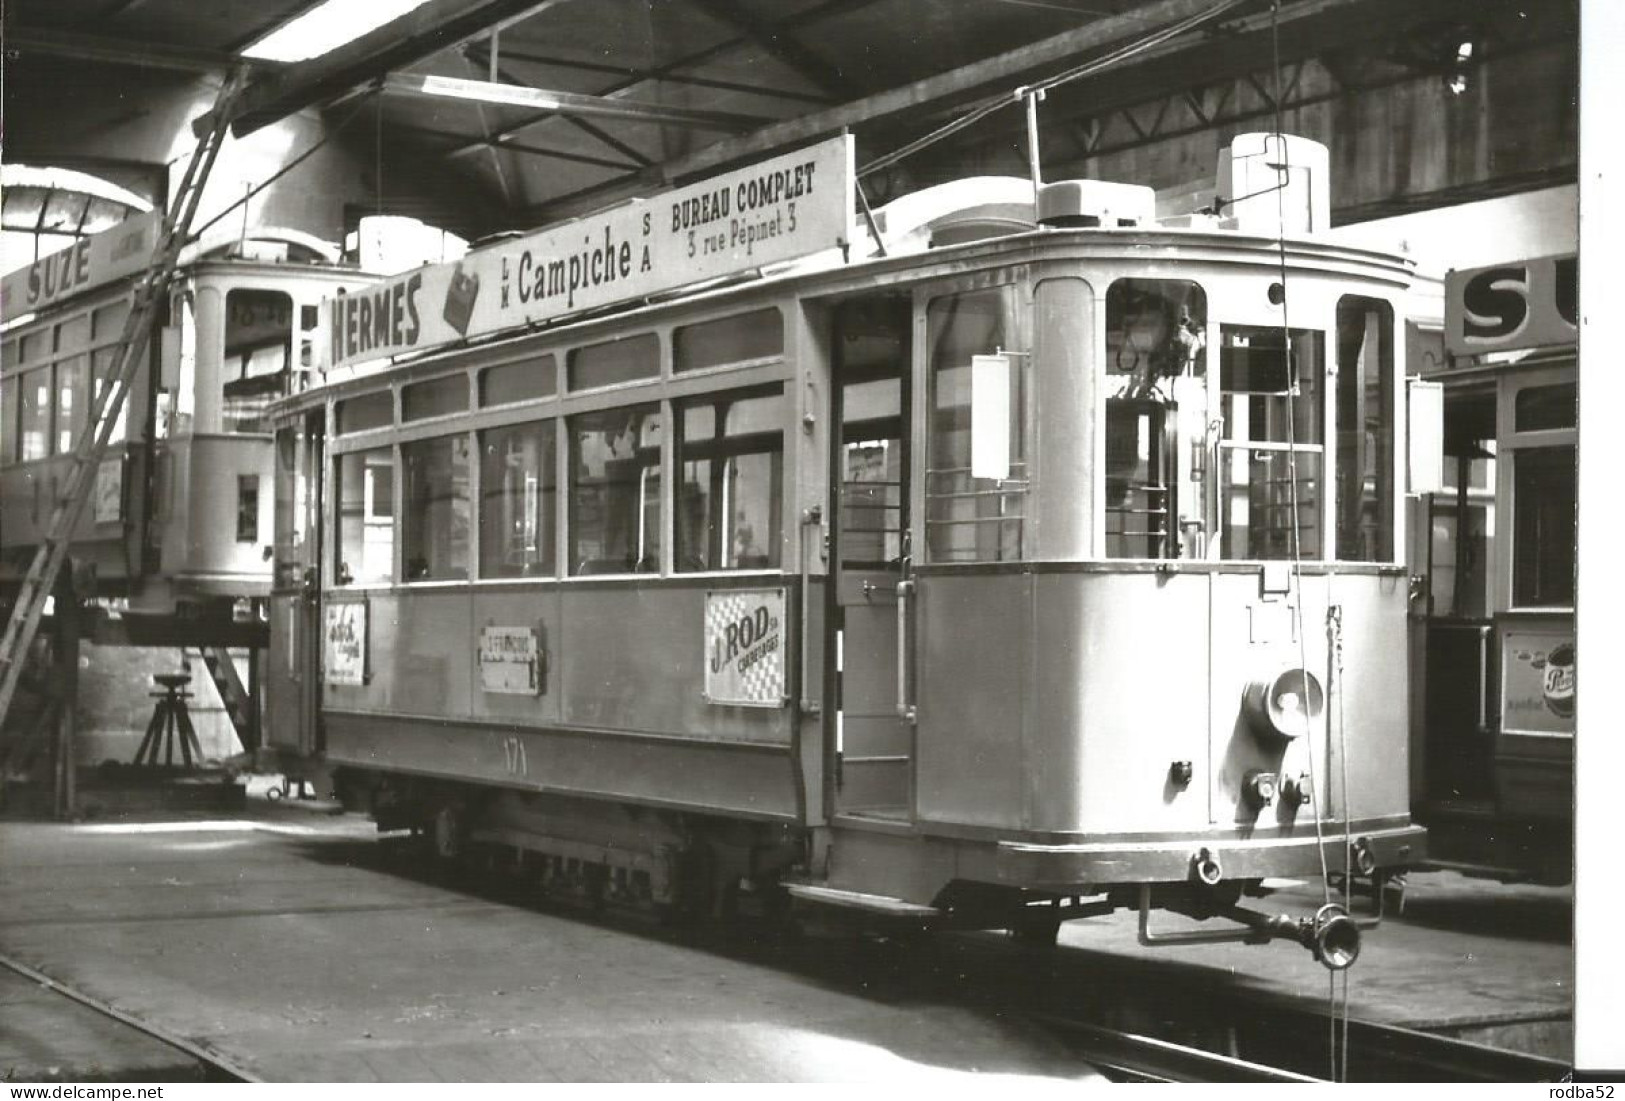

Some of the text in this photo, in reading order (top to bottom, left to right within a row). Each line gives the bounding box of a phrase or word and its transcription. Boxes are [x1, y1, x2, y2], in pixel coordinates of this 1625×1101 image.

[672, 161, 816, 233] BUREAU COMPLET
[688, 202, 797, 258] 3 rue Pépinet 3
[27, 239, 91, 304] SUZE
[519, 225, 631, 308] Campiche
[331, 272, 422, 367] HERMES
[504, 738, 528, 776] 171
